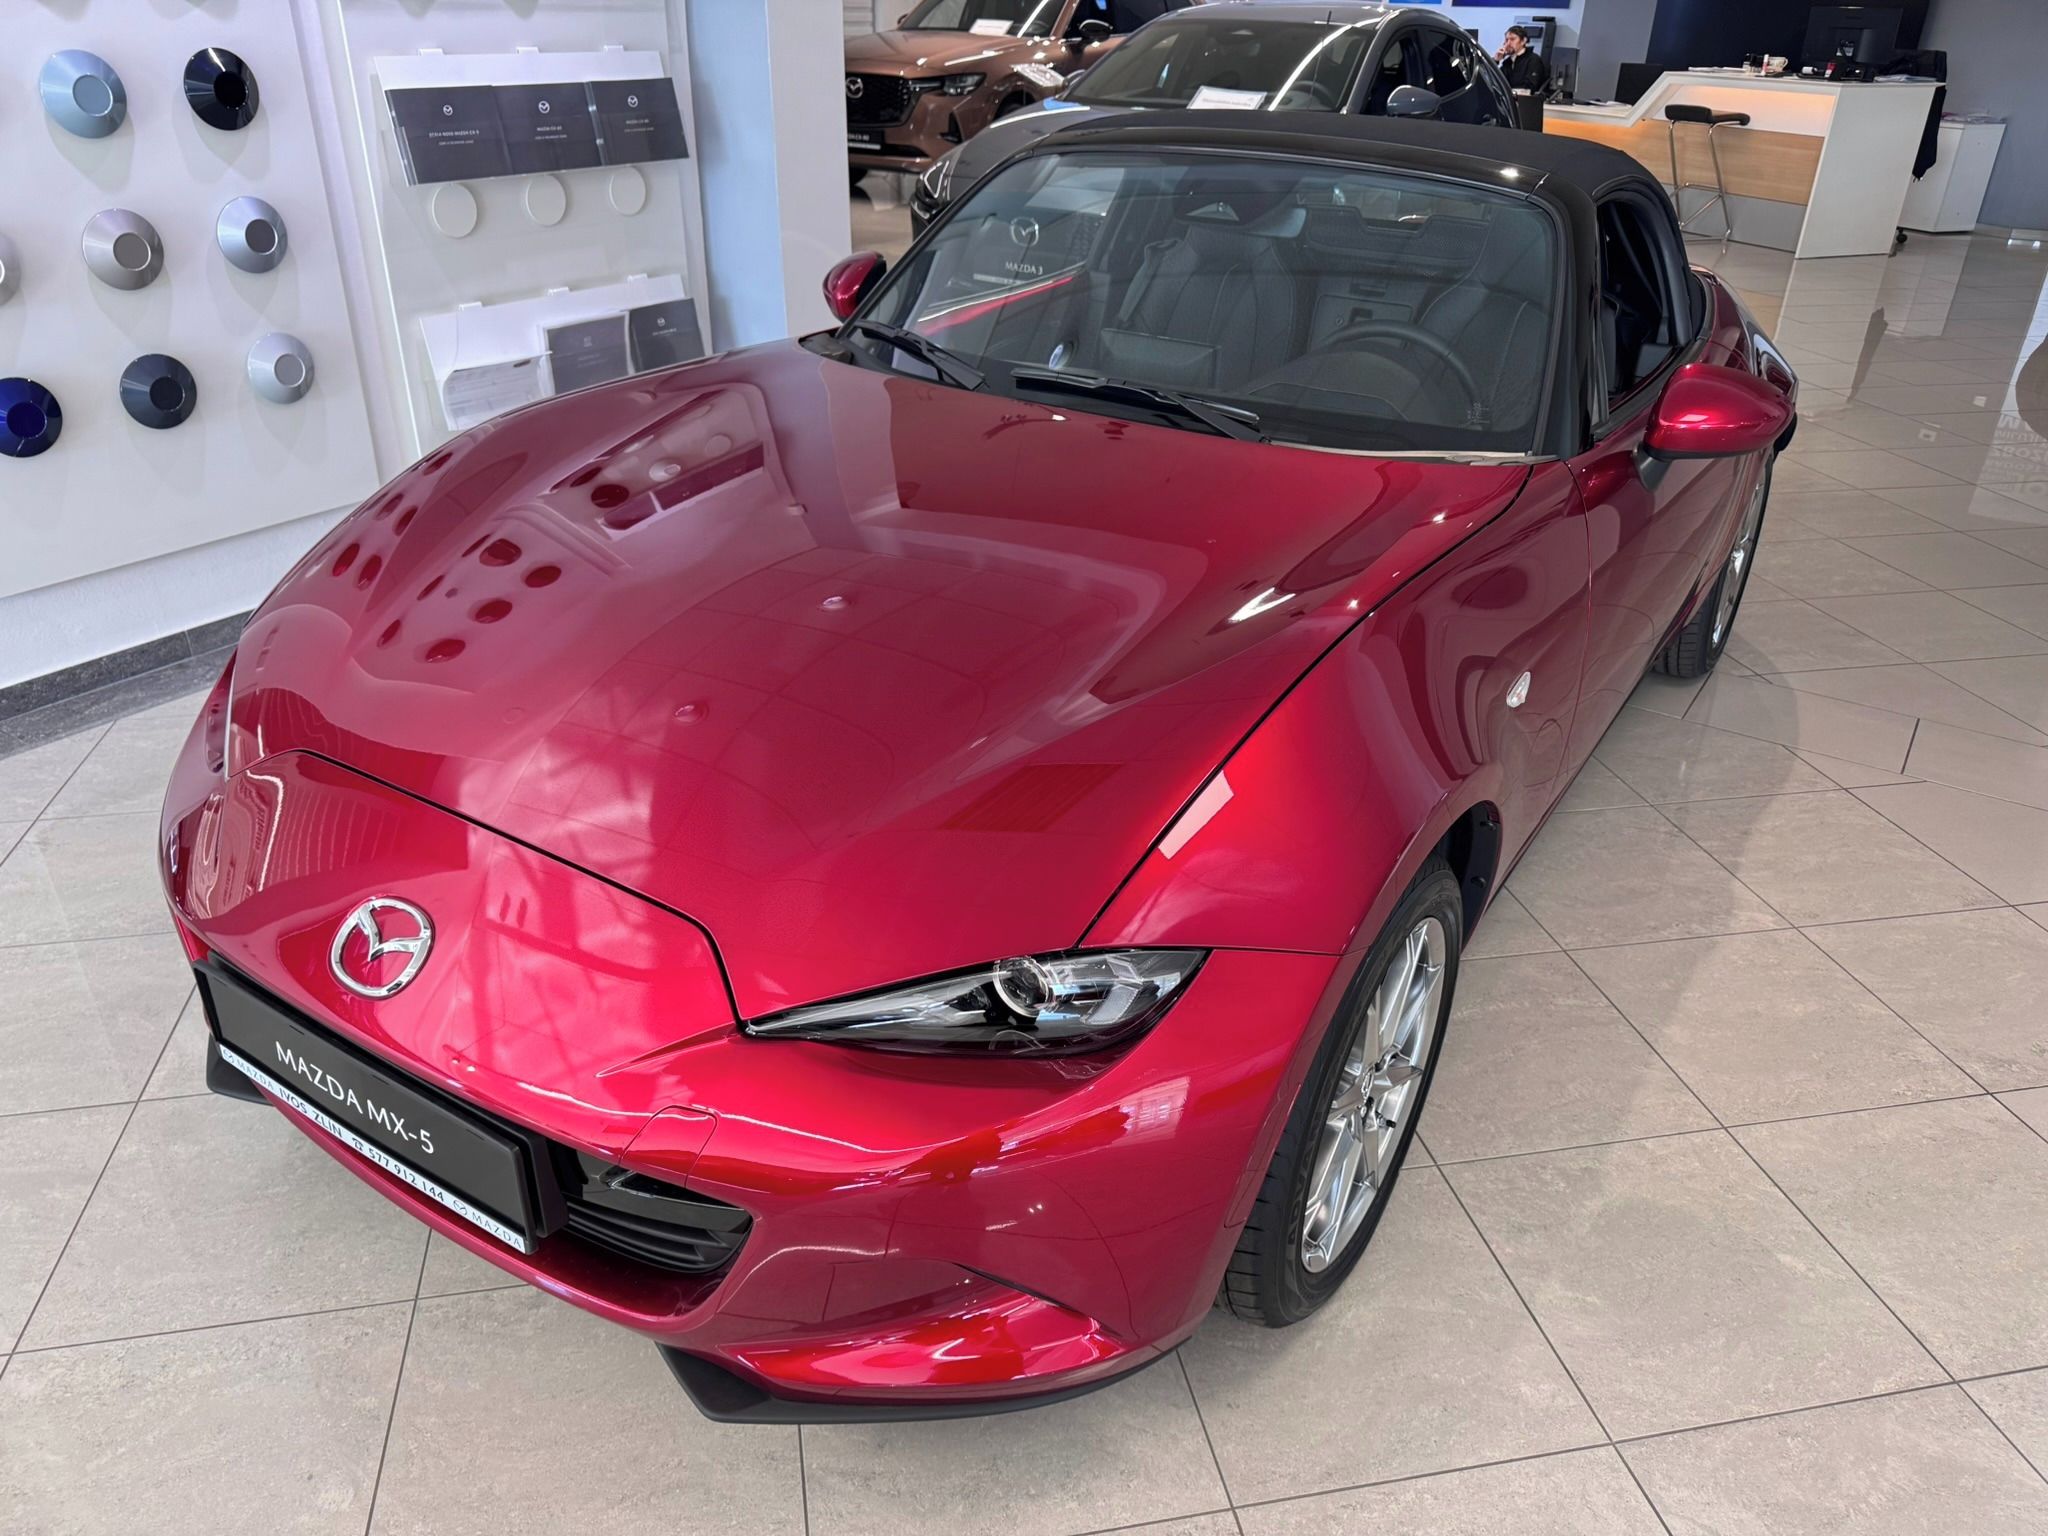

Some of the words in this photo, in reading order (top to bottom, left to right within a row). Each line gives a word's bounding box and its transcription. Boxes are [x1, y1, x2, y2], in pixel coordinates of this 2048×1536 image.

[1005, 261, 1036, 274] MAZDA
[1037, 265, 1043, 276] 3
[236, 1057, 275, 1091] MAZDA
[279, 1087, 308, 1114] IVOS
[368, 1147, 390, 1168] 577
[394, 1164, 418, 1186] 912
[422, 1181, 445, 1202] 144
[471, 1212, 522, 1249] MAZDA
[275, 1040, 363, 1115] MAZDA
[366, 1099, 434, 1154] MX-5
